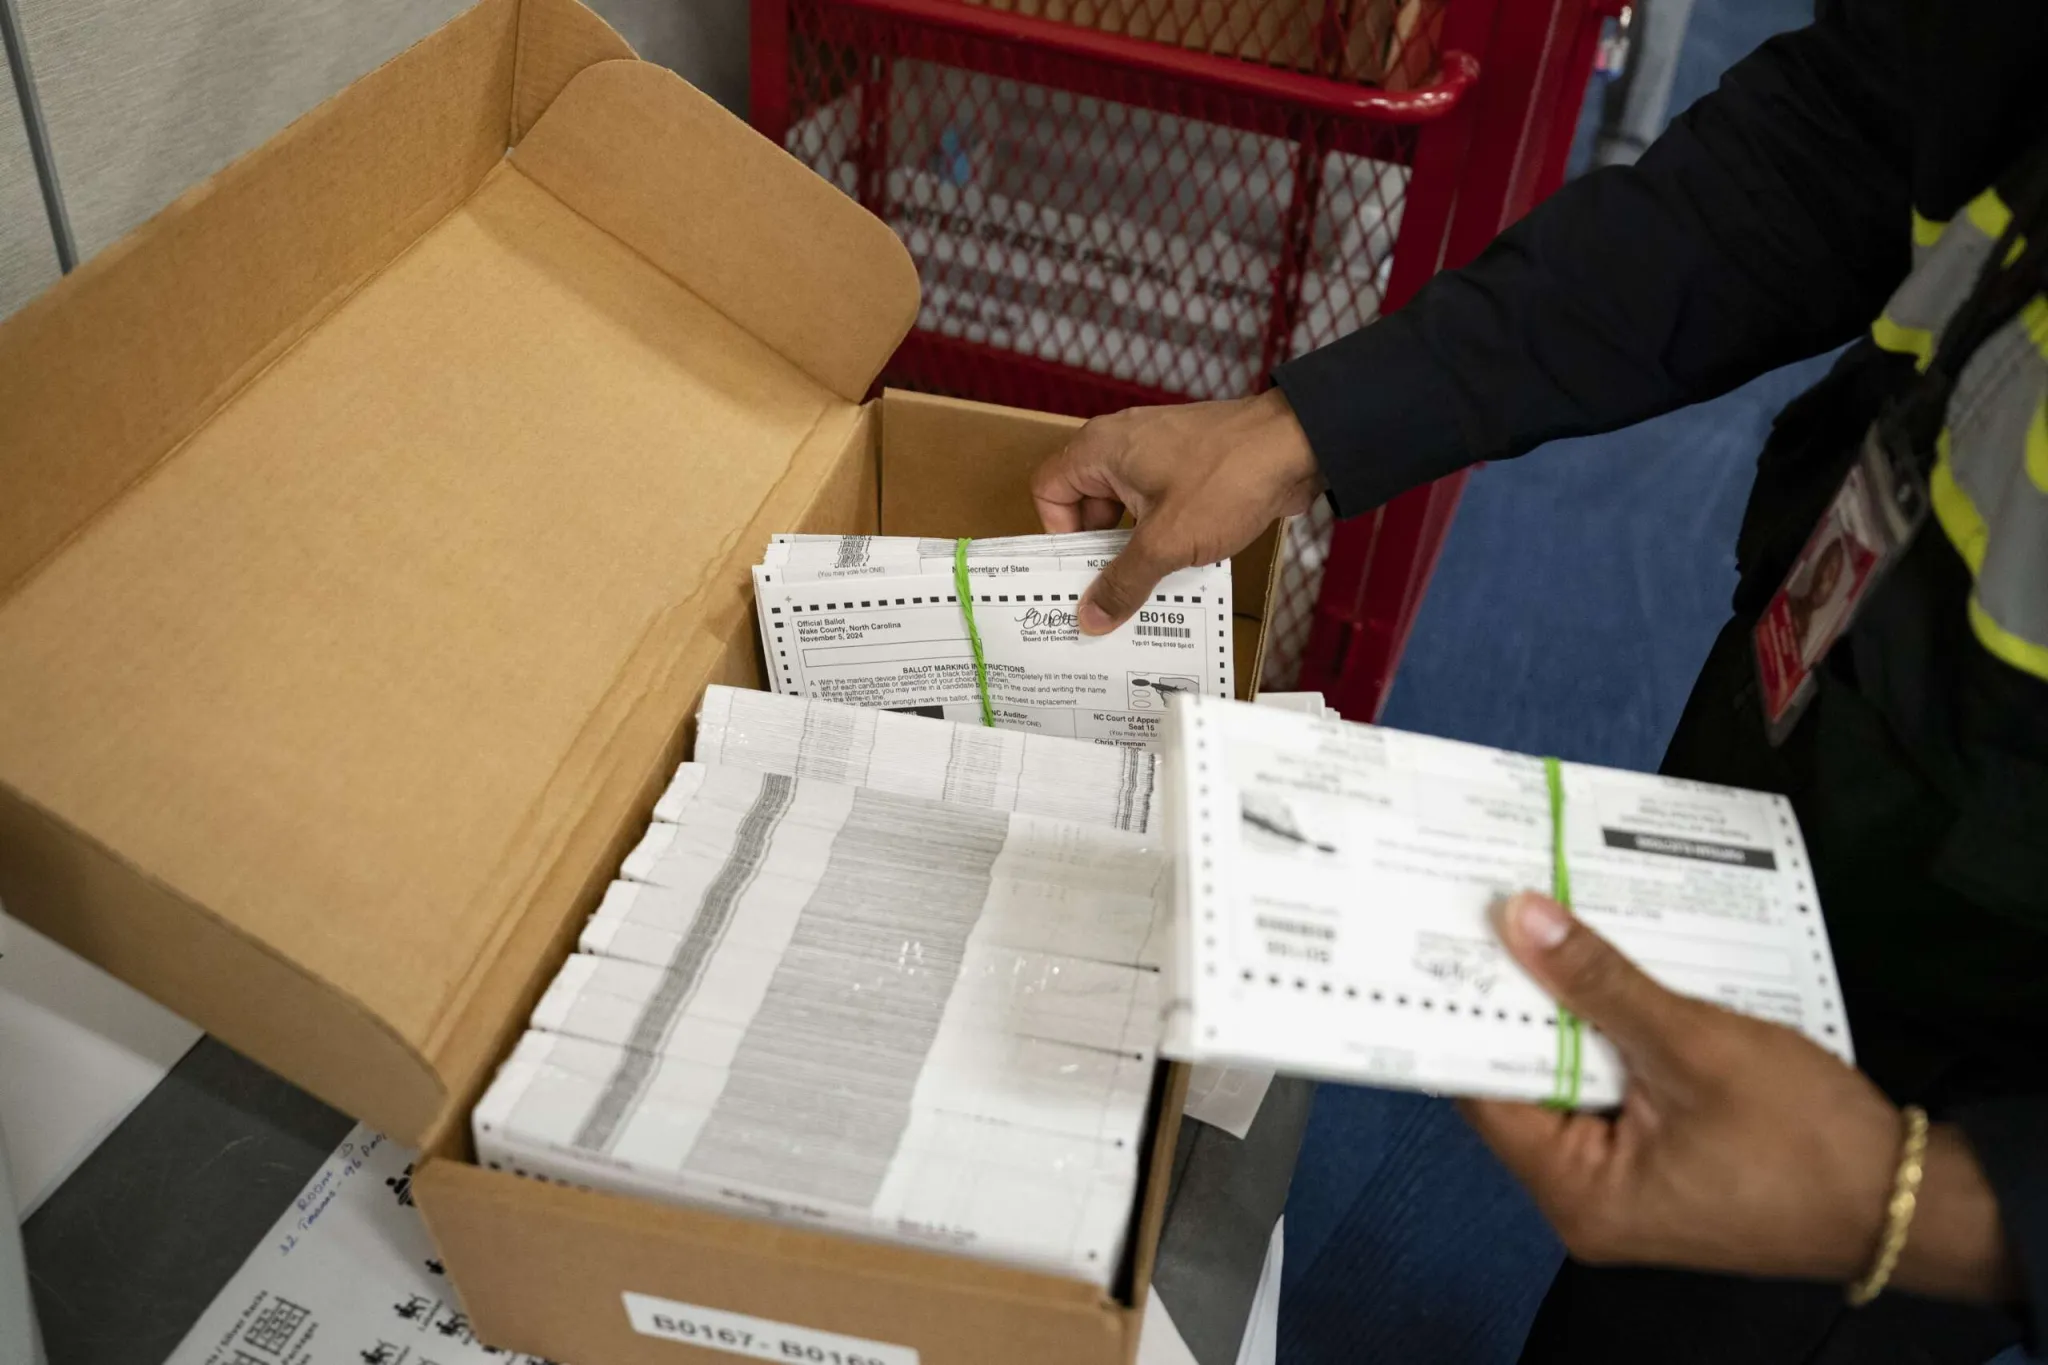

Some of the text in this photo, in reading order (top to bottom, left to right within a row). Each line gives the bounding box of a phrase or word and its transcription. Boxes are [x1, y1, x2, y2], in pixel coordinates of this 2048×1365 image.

[1087, 559, 1099, 567] NC
[1001, 565, 1009, 573] of
[1010, 565, 1030, 573] State
[797, 618, 846, 627] Official Ballot
[1139, 610, 1185, 625] B0169
[798, 622, 902, 635] Wake County, North Carolina
[1058, 628, 1080, 636] County
[846, 632, 864, 640] 2024
[902, 663, 1026, 674] BALLOT MARKING INTRUCTIONS
[847, 677, 873, 686] marking
[874, 675, 897, 683] device
[897, 673, 927, 682] provided
[942, 670, 960, 678] black
[1008, 672, 1044, 682] completely
[857, 681, 891, 690] candidate
[899, 679, 930, 687] selection
[939, 678, 954, 686] your
[820, 690, 843, 698] Where
[881, 688, 895, 696] you
[895, 686, 910, 694] may
[942, 681, 975, 690] candidate
[1010, 684, 1022, 692] the
[1051, 685, 1075, 694] writing
[1075, 685, 1087, 693] the
[1087, 686, 1107, 694] name
[891, 697, 917, 706] wrongly
[918, 695, 935, 703] mark
[1005, 694, 1029, 705] request
[991, 709, 1029, 719] NC Auditor
[1093, 713, 1105, 721] NC
[1105, 713, 1127, 723] Court
[1127, 714, 1136, 723] of
[1128, 723, 1155, 732] Seat 15
[1094, 738, 1147, 748] Chris Freeman
[652, 1313, 754, 1347] B0167
